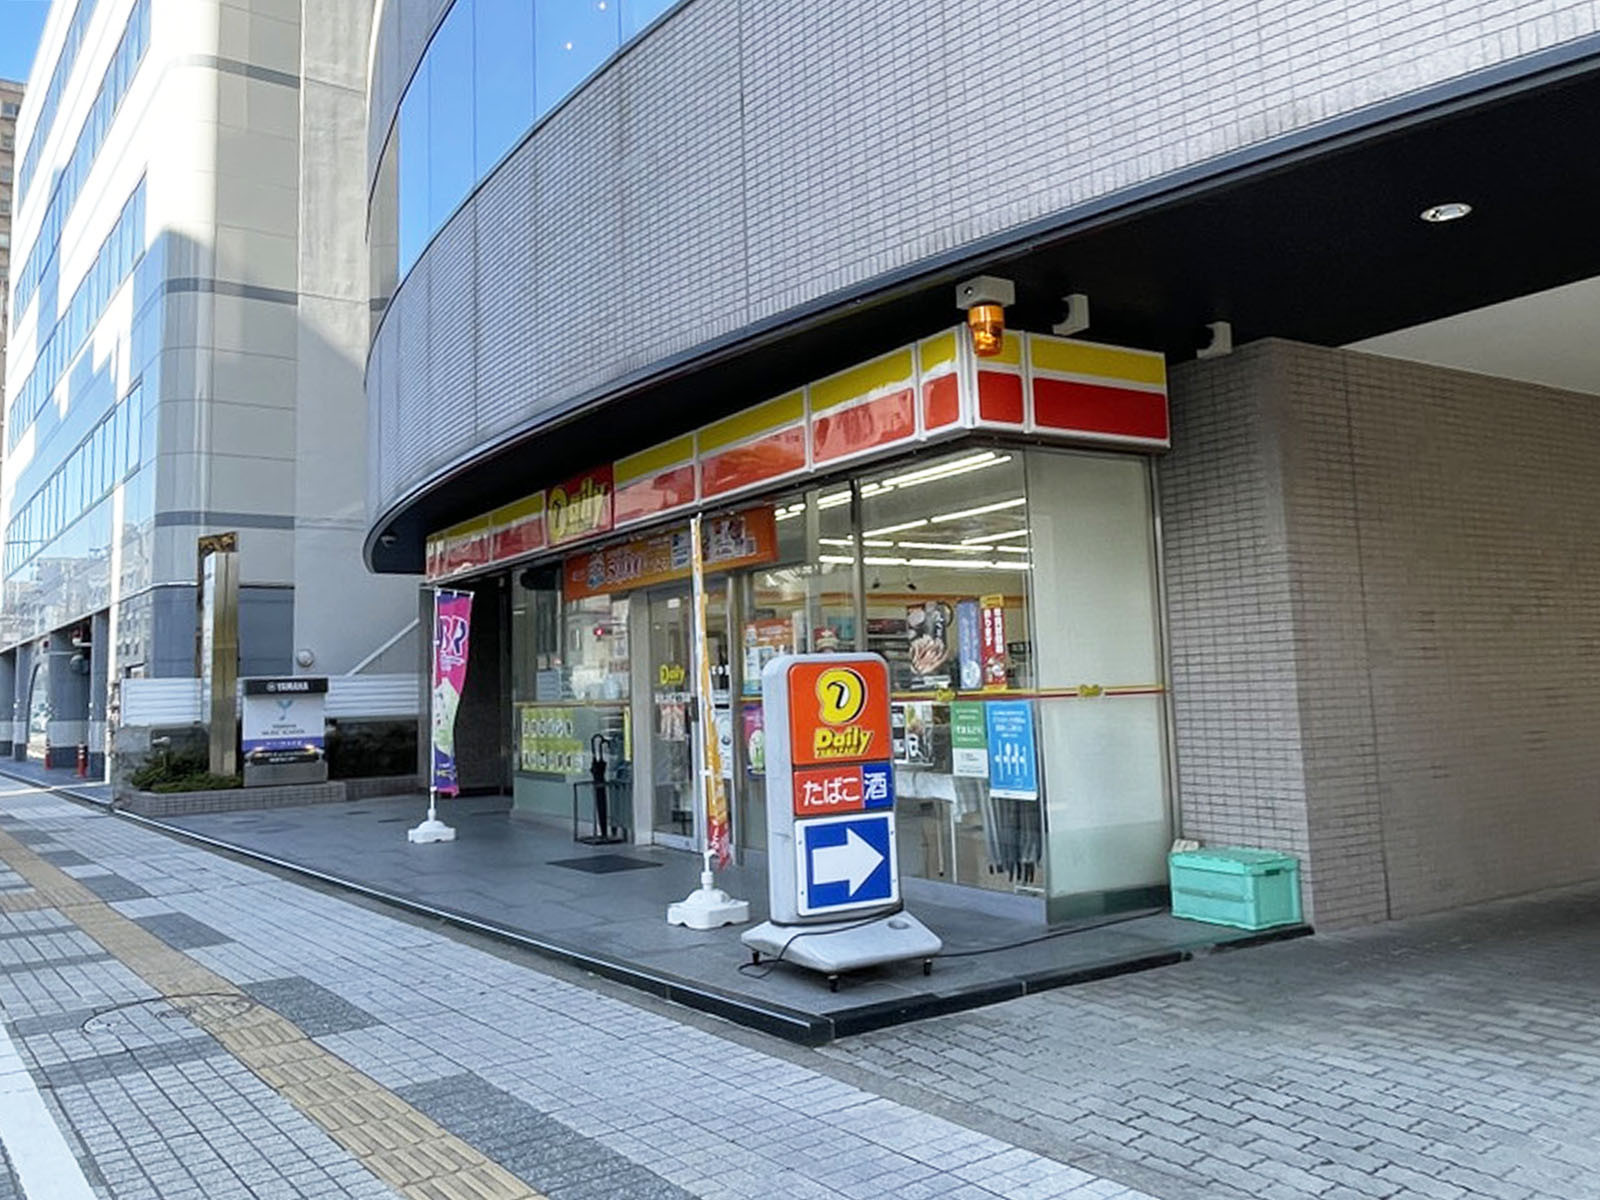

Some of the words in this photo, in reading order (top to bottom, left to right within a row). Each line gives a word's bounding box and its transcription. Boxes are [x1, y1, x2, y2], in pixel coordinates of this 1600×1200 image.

[276, 682, 309, 692] YAMAHA
[660, 663, 686, 686] Daily
[815, 727, 874, 755] Daily
[803, 776, 861, 807] たばこ
[864, 771, 888, 801] 酒
